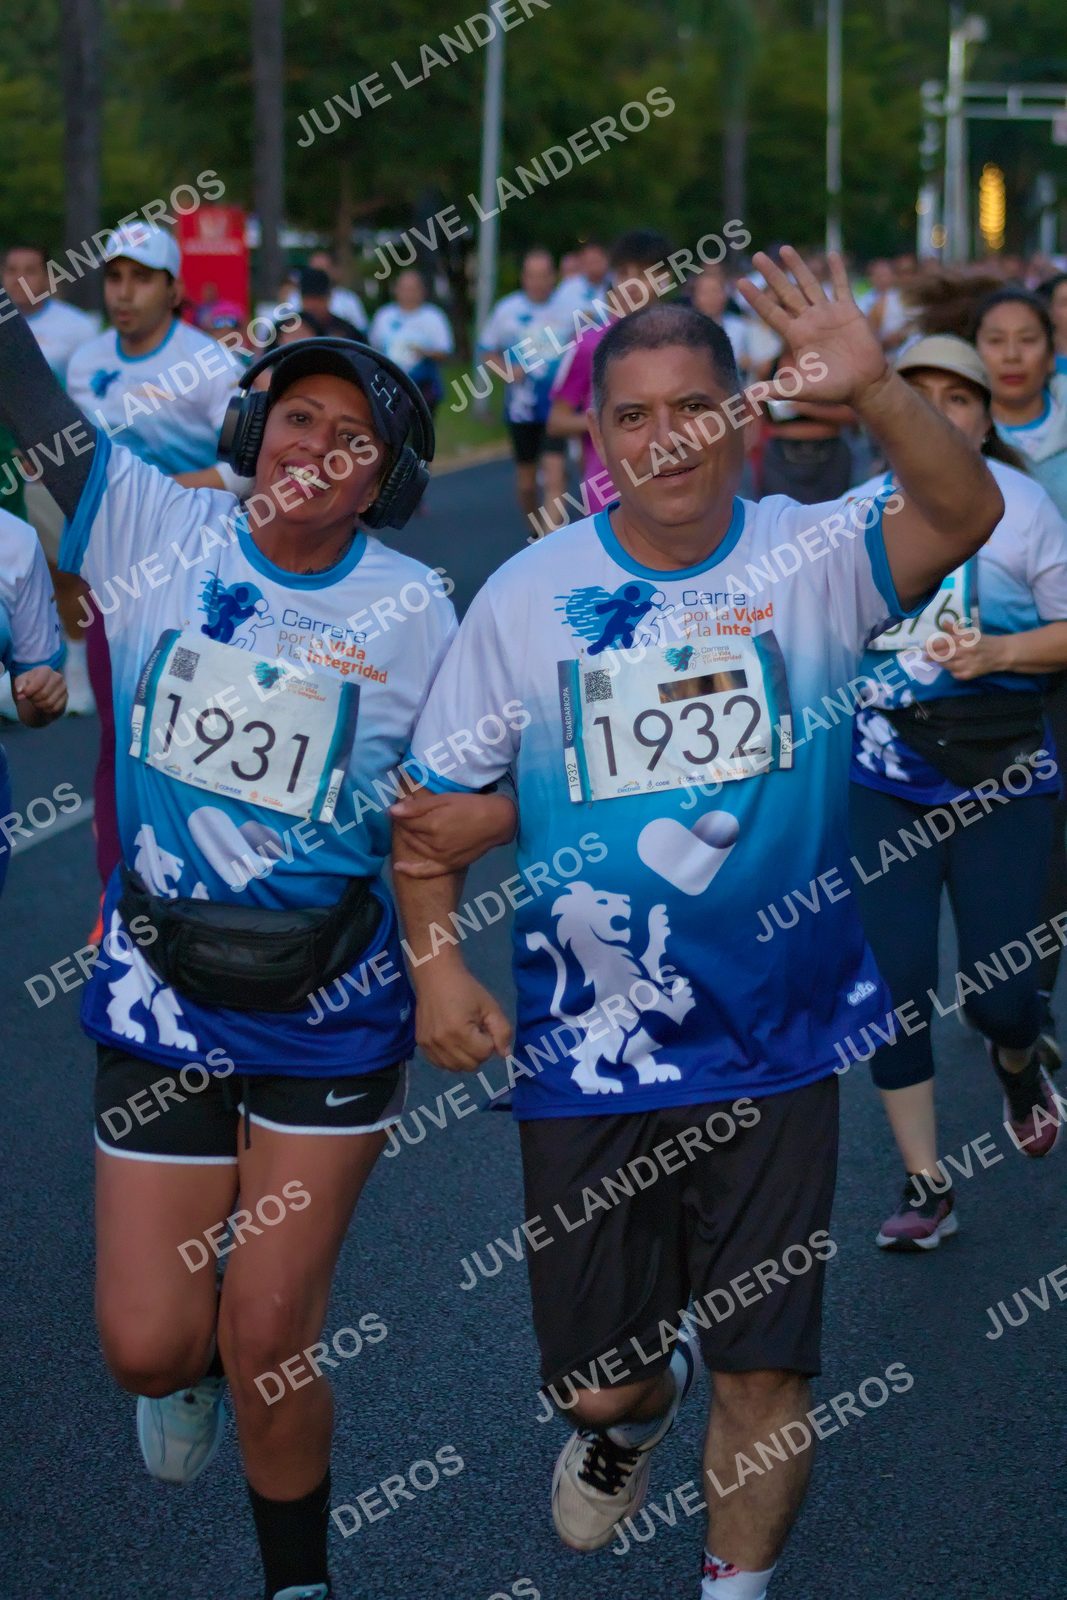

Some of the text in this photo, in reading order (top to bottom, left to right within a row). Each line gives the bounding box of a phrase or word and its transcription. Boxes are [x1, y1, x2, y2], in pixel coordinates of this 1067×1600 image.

[282, 609, 367, 643] Carrera
[683, 611, 708, 625] por
[715, 607, 729, 621] la
[697, 623, 711, 637] la
[716, 622, 751, 636] Inte
[276, 643, 285, 657] y
[289, 644, 302, 660] la
[278, 630, 366, 660] por la Vida
[563, 687, 573, 741] GUARDARROPA
[163, 693, 310, 793] 1931
[593, 695, 766, 777] 1932
[782, 730, 791, 754] 1932
[567, 763, 579, 788] 1932
[325, 786, 339, 809] 1931
